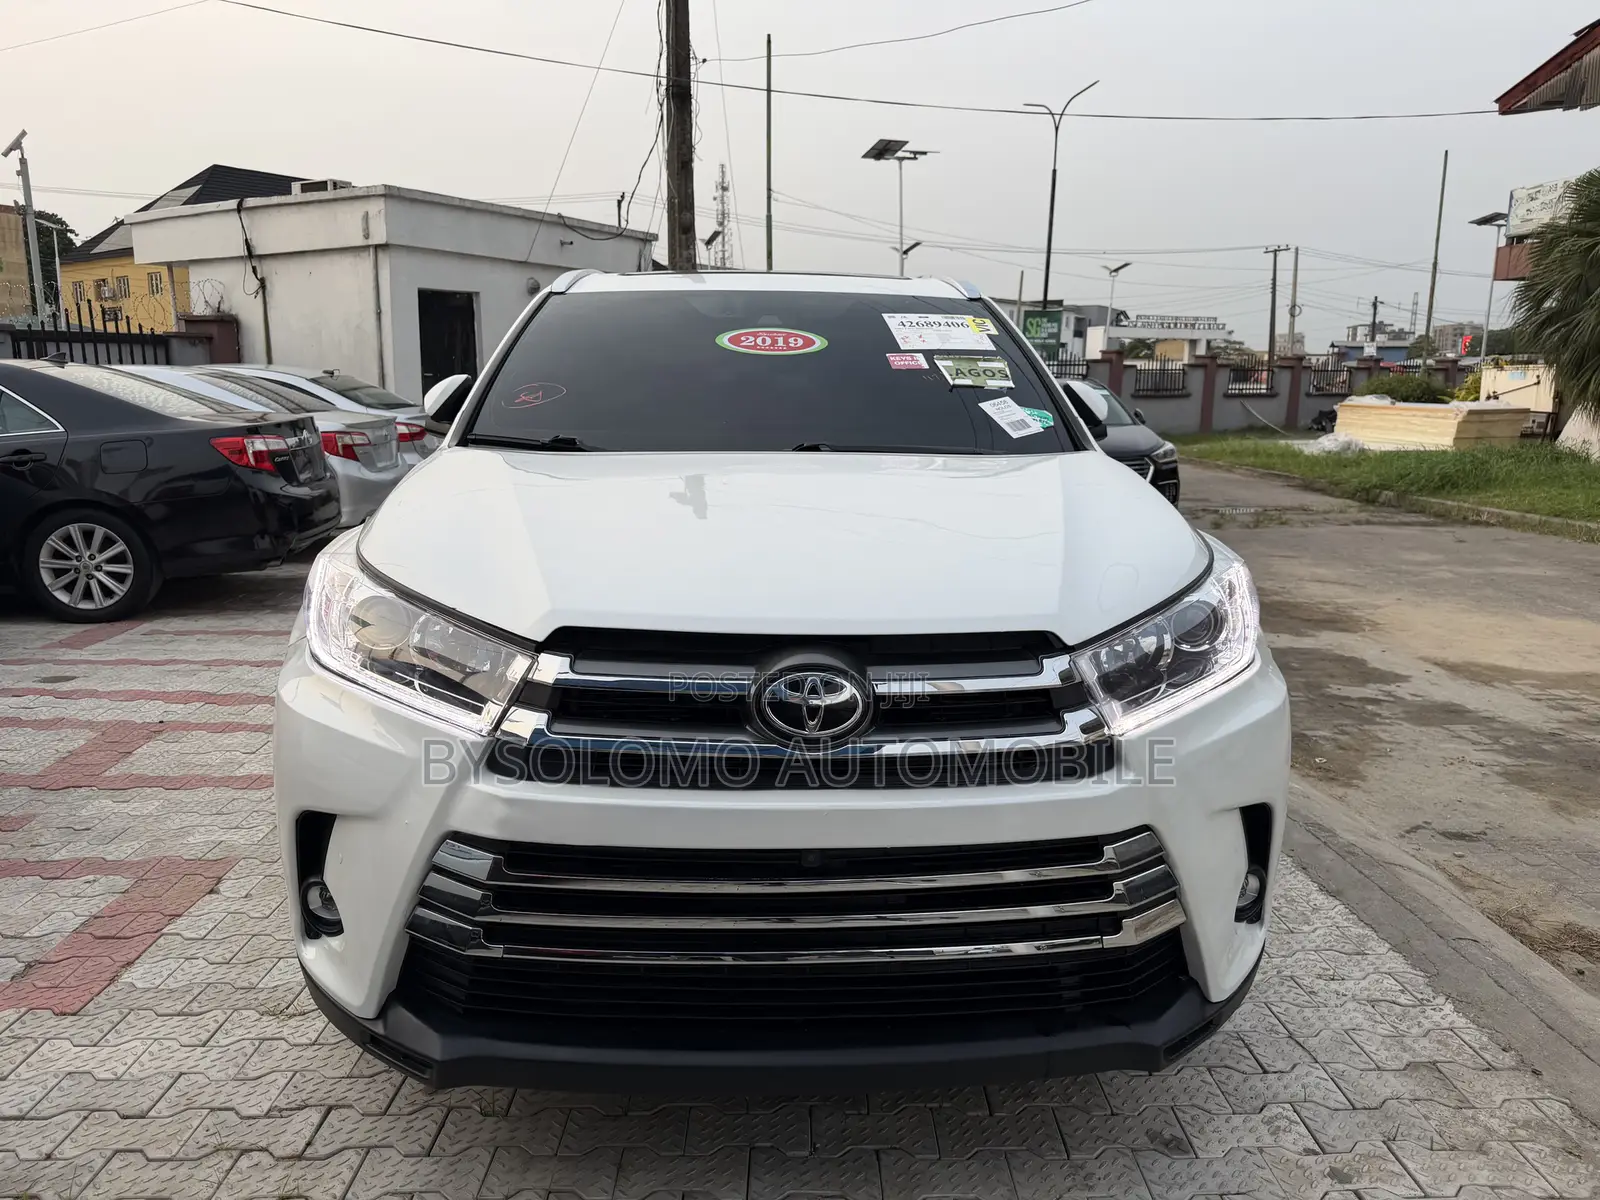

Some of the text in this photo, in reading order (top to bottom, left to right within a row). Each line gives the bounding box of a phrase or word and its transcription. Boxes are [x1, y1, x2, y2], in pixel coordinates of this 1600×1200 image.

[972, 319, 991, 332] VIC
[1025, 317, 1041, 337] SG
[739, 335, 804, 347] 2019
